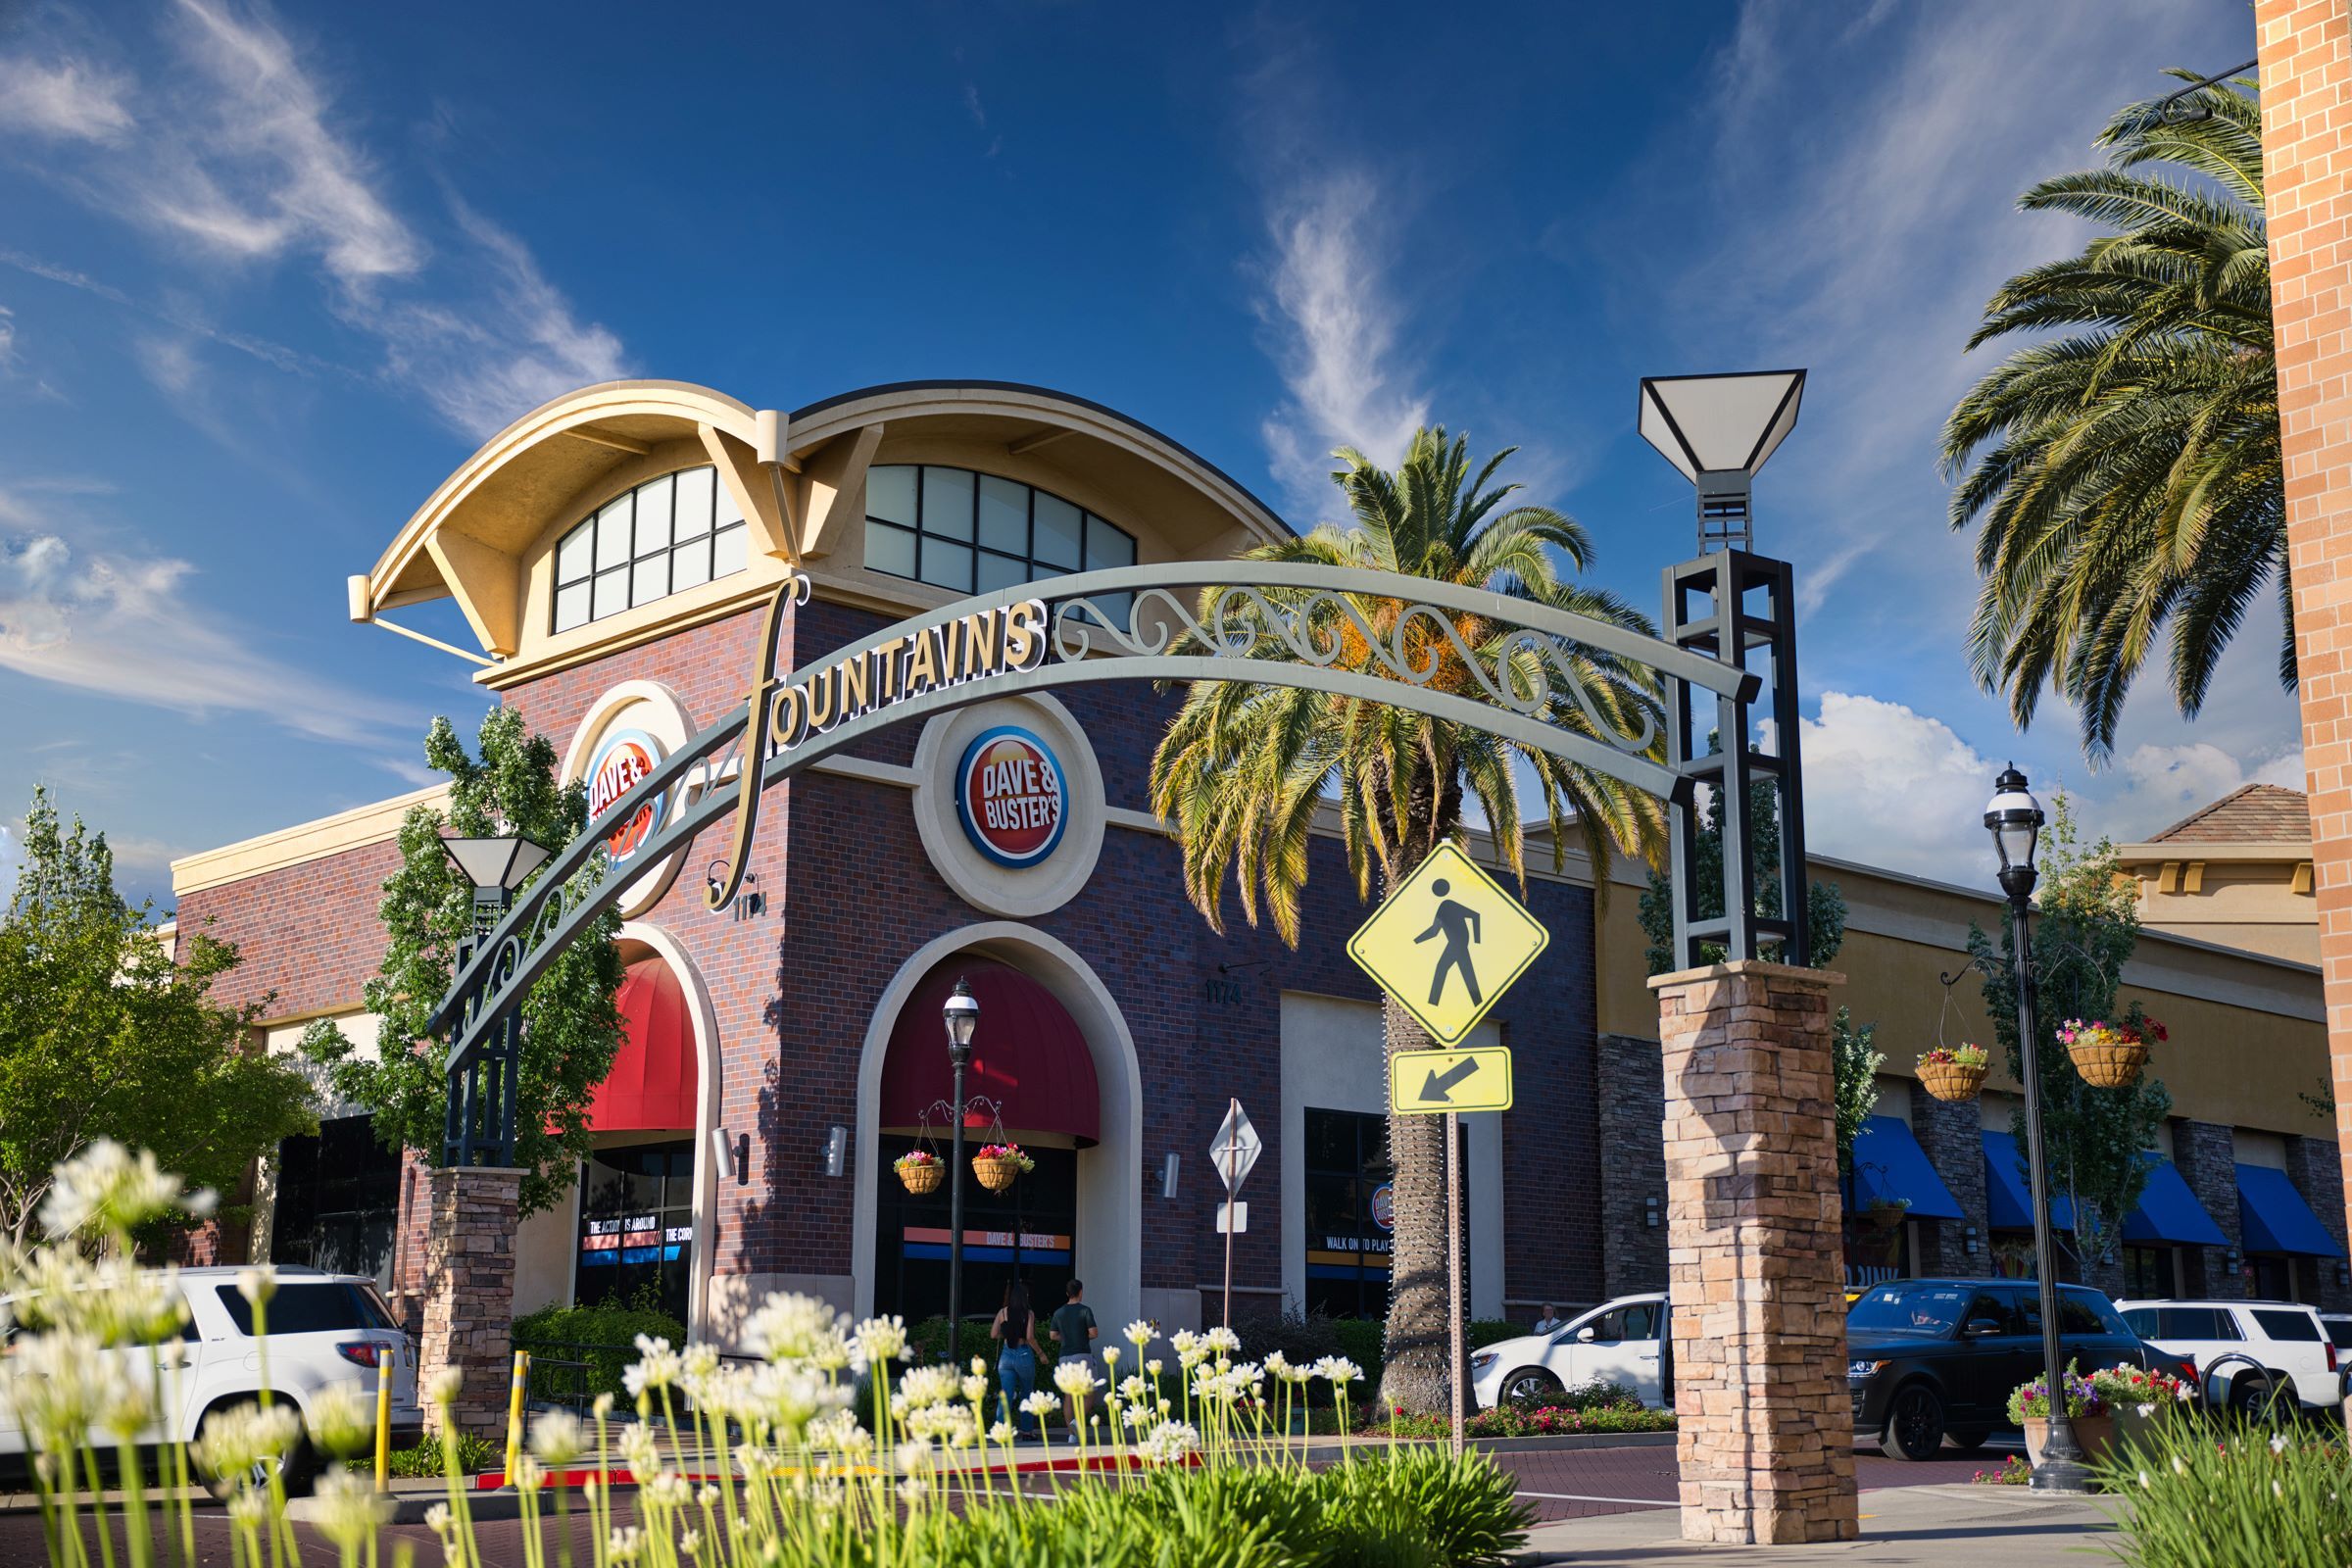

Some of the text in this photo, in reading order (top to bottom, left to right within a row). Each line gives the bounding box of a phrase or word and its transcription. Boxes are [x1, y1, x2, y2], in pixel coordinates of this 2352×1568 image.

[590, 754, 643, 809] DAVE &
[983, 760, 1058, 799] DAVE &
[985, 795, 1058, 830] BUSTER'S
[1206, 980, 1241, 1004] 1174
[590, 1216, 655, 1234] THE ACTION IS AROUND
[665, 1228, 677, 1242] THE
[987, 1232, 1054, 1249] DAVE & BUSTER'S
[1326, 1236, 1348, 1250] WALK
[1348, 1238, 1359, 1250] ON
[1372, 1239, 1389, 1251] PLAY
